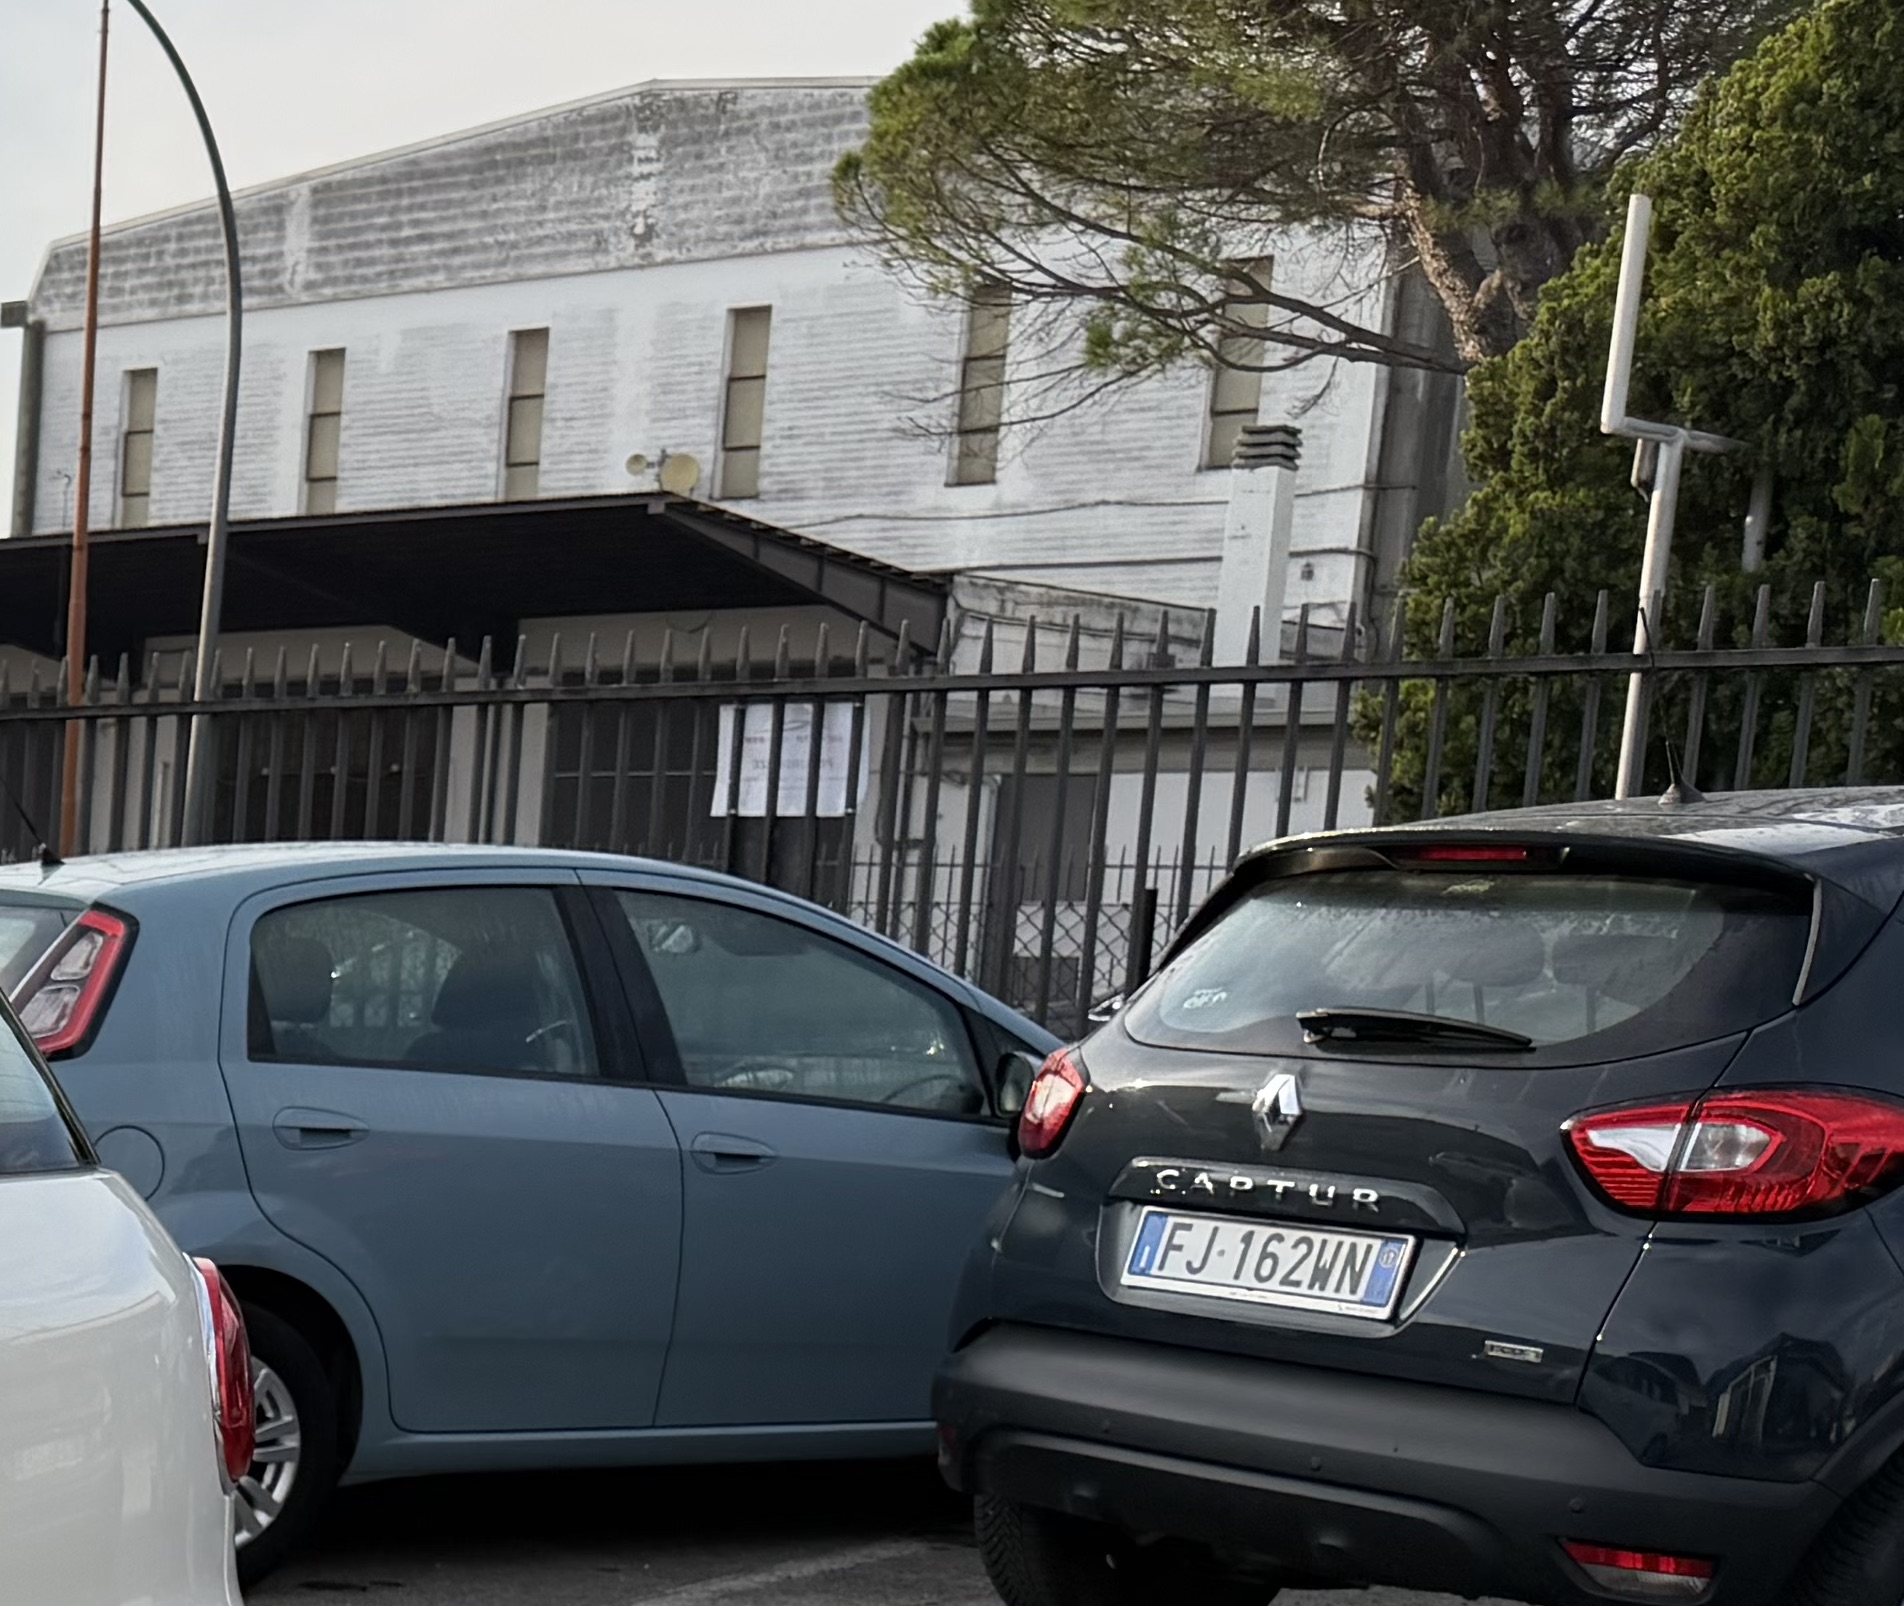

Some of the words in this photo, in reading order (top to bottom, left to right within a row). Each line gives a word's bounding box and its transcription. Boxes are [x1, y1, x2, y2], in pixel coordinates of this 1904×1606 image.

[1155, 1168, 1379, 1213] CAPTUR
[1158, 1222, 1219, 1275] FJ
[1233, 1230, 1373, 1295] 162WN
